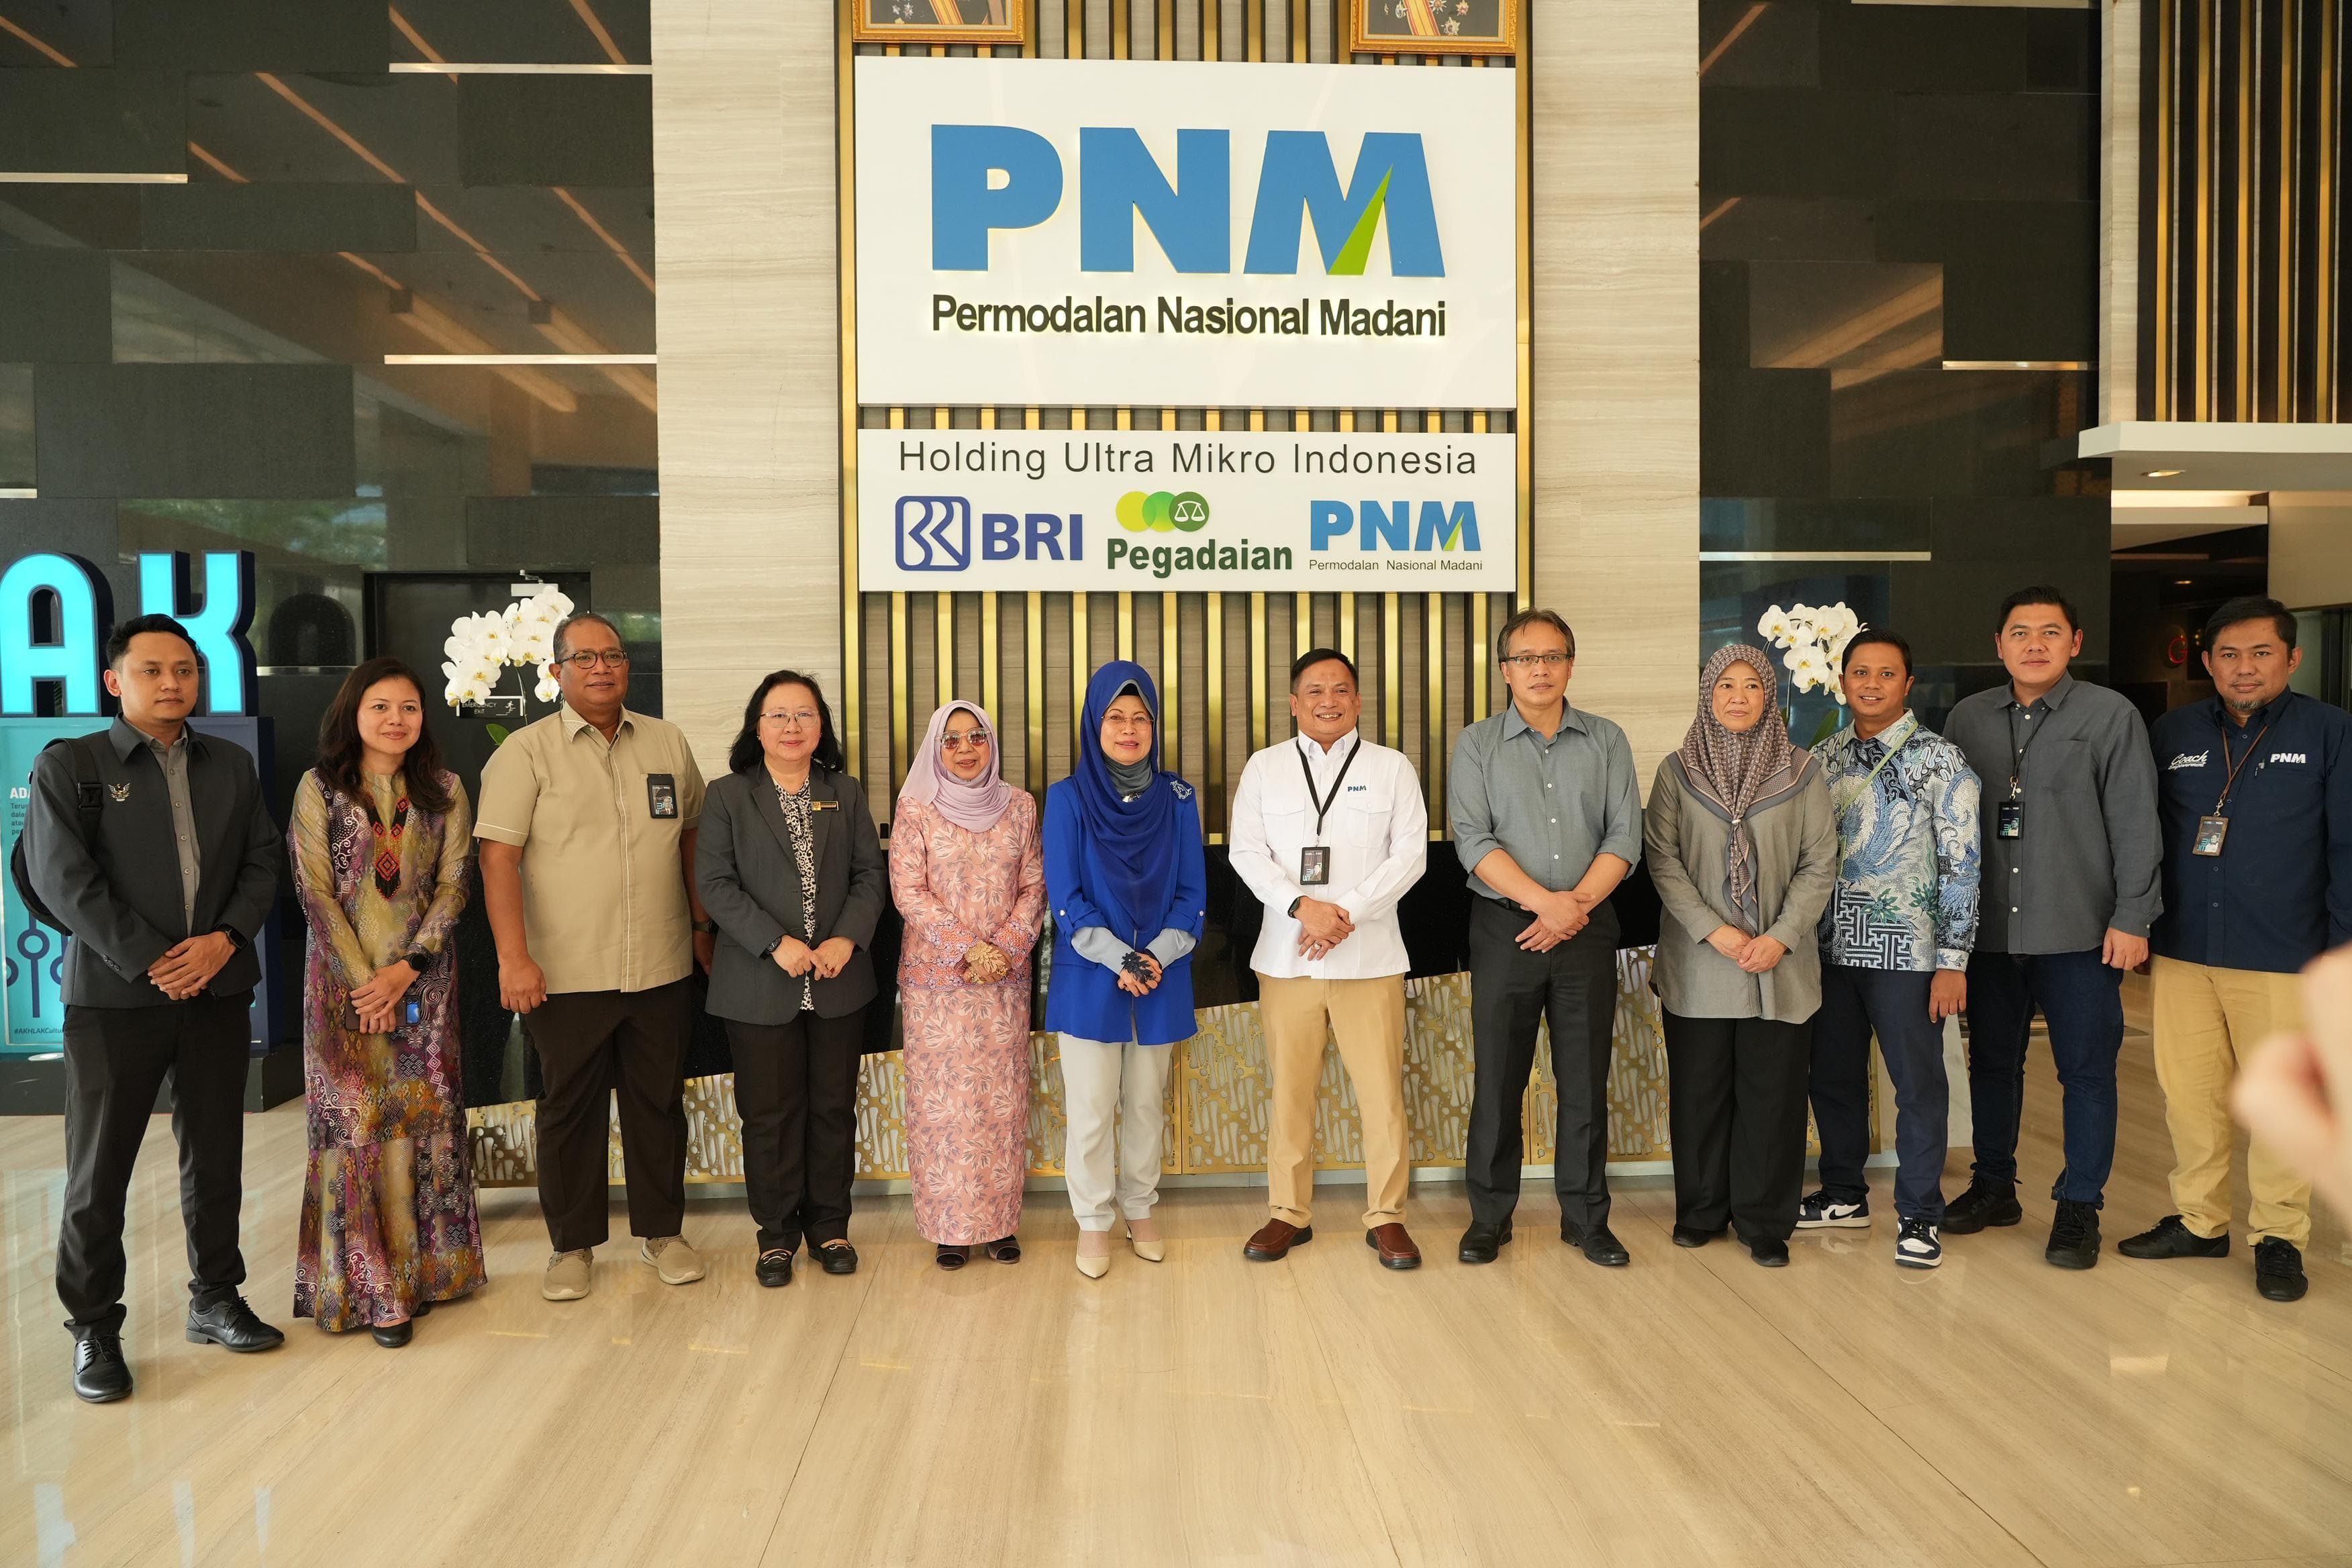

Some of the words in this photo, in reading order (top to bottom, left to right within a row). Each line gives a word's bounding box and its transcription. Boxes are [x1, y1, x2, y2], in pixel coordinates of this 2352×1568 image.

[931, 124, 1446, 277] PNM
[932, 294, 1146, 334] Permodalan
[1157, 296, 1310, 336] Nasional
[1319, 298, 1446, 337] Madani
[899, 440, 1046, 481] Holding
[1065, 441, 1154, 473] Ultra
[1172, 442, 1275, 475] Mikro
[1294, 442, 1476, 475] Indonesia
[981, 513, 1083, 562] BRI
[1310, 500, 1482, 552] PNM
[1106, 538, 1293, 579] Pegadaian
[1309, 559, 1379, 571] Permodalan
[1386, 560, 1437, 571] Nasional
[1440, 560, 1483, 571] Madani
[2270, 752, 2306, 764] PNM
